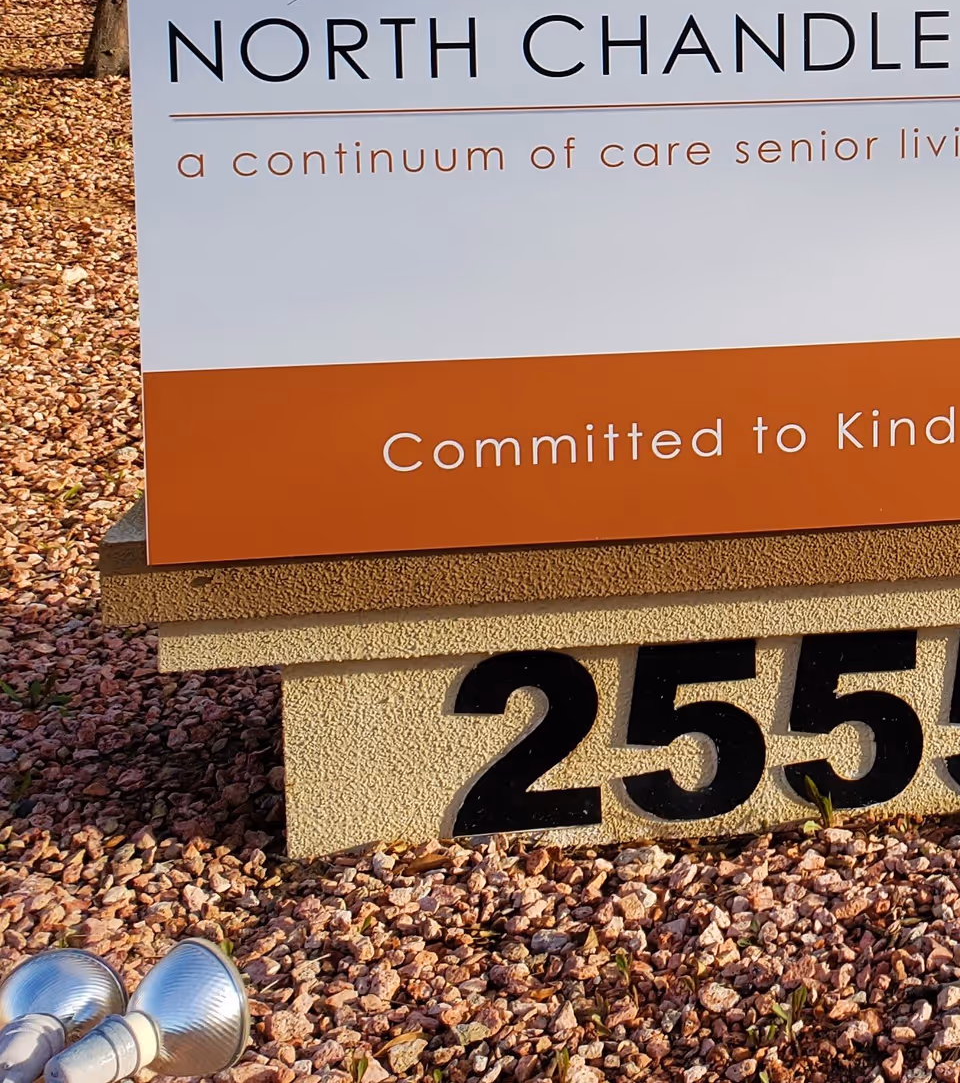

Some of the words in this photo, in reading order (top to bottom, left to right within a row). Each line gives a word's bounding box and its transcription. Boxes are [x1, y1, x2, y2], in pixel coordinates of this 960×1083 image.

[168, 17, 477, 83] NORTH
[177, 153, 205, 179] a
[232, 141, 505, 177] continuum
[530, 136, 576, 170] of
[600, 141, 712, 169] care
[735, 130, 879, 165] senior
[383, 418, 723, 472] Committed
[752, 416, 806, 454] to
